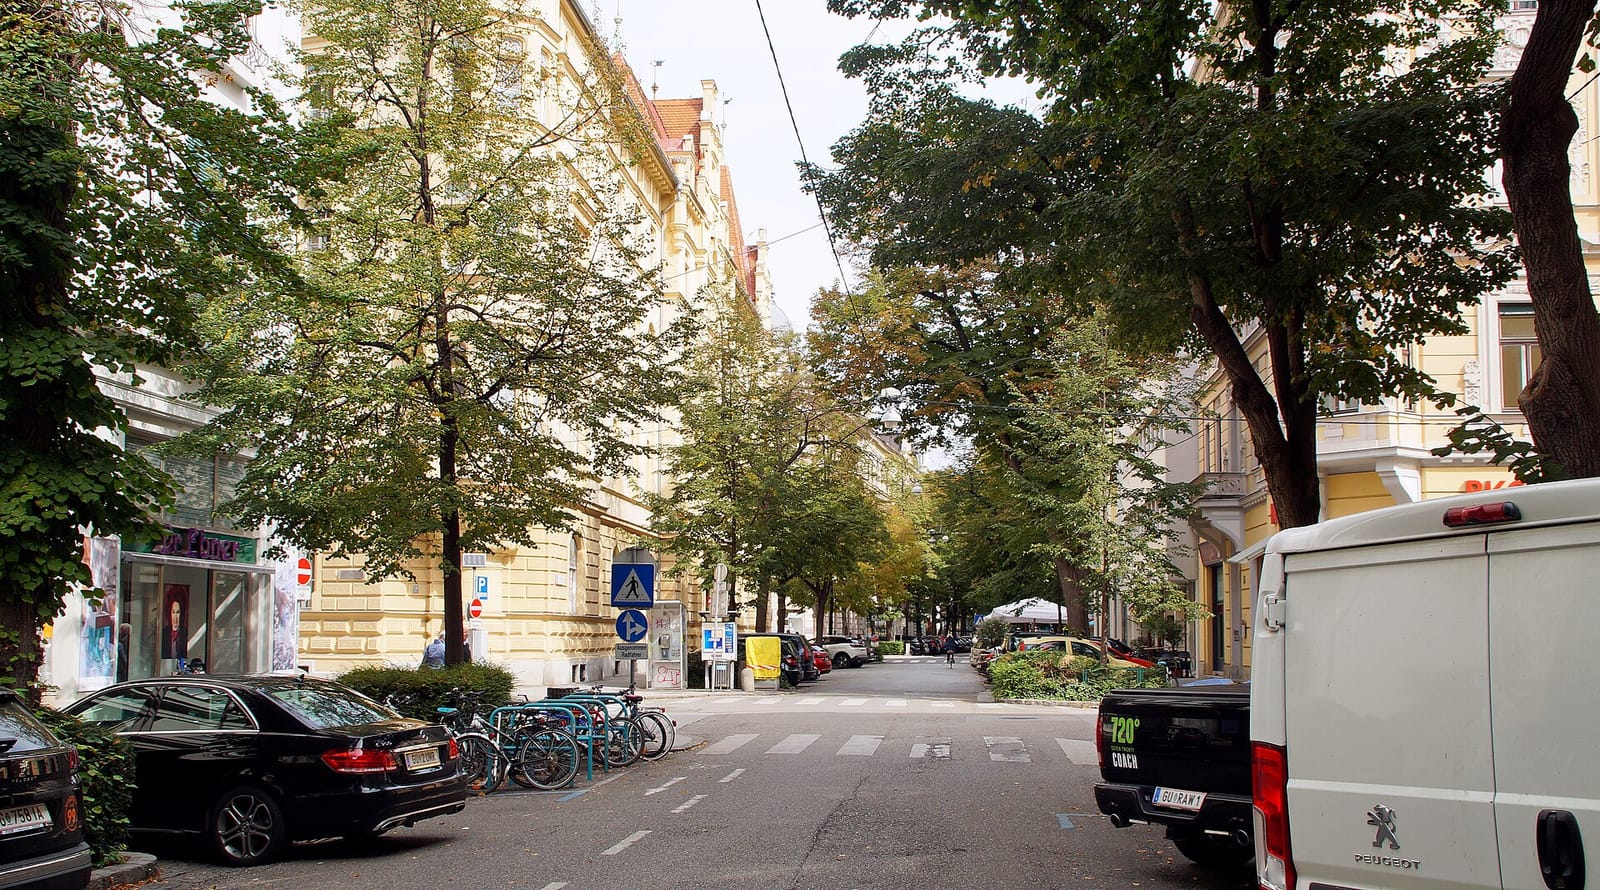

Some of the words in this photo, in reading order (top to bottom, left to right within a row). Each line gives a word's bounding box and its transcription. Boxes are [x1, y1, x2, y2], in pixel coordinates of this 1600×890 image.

[479, 577, 487, 593] P
[1111, 752, 1138, 769] COACH
[1162, 790, 1174, 802] GU
[1176, 792, 1196, 805] RAW
[1354, 853, 1421, 870] PEUGEOT
